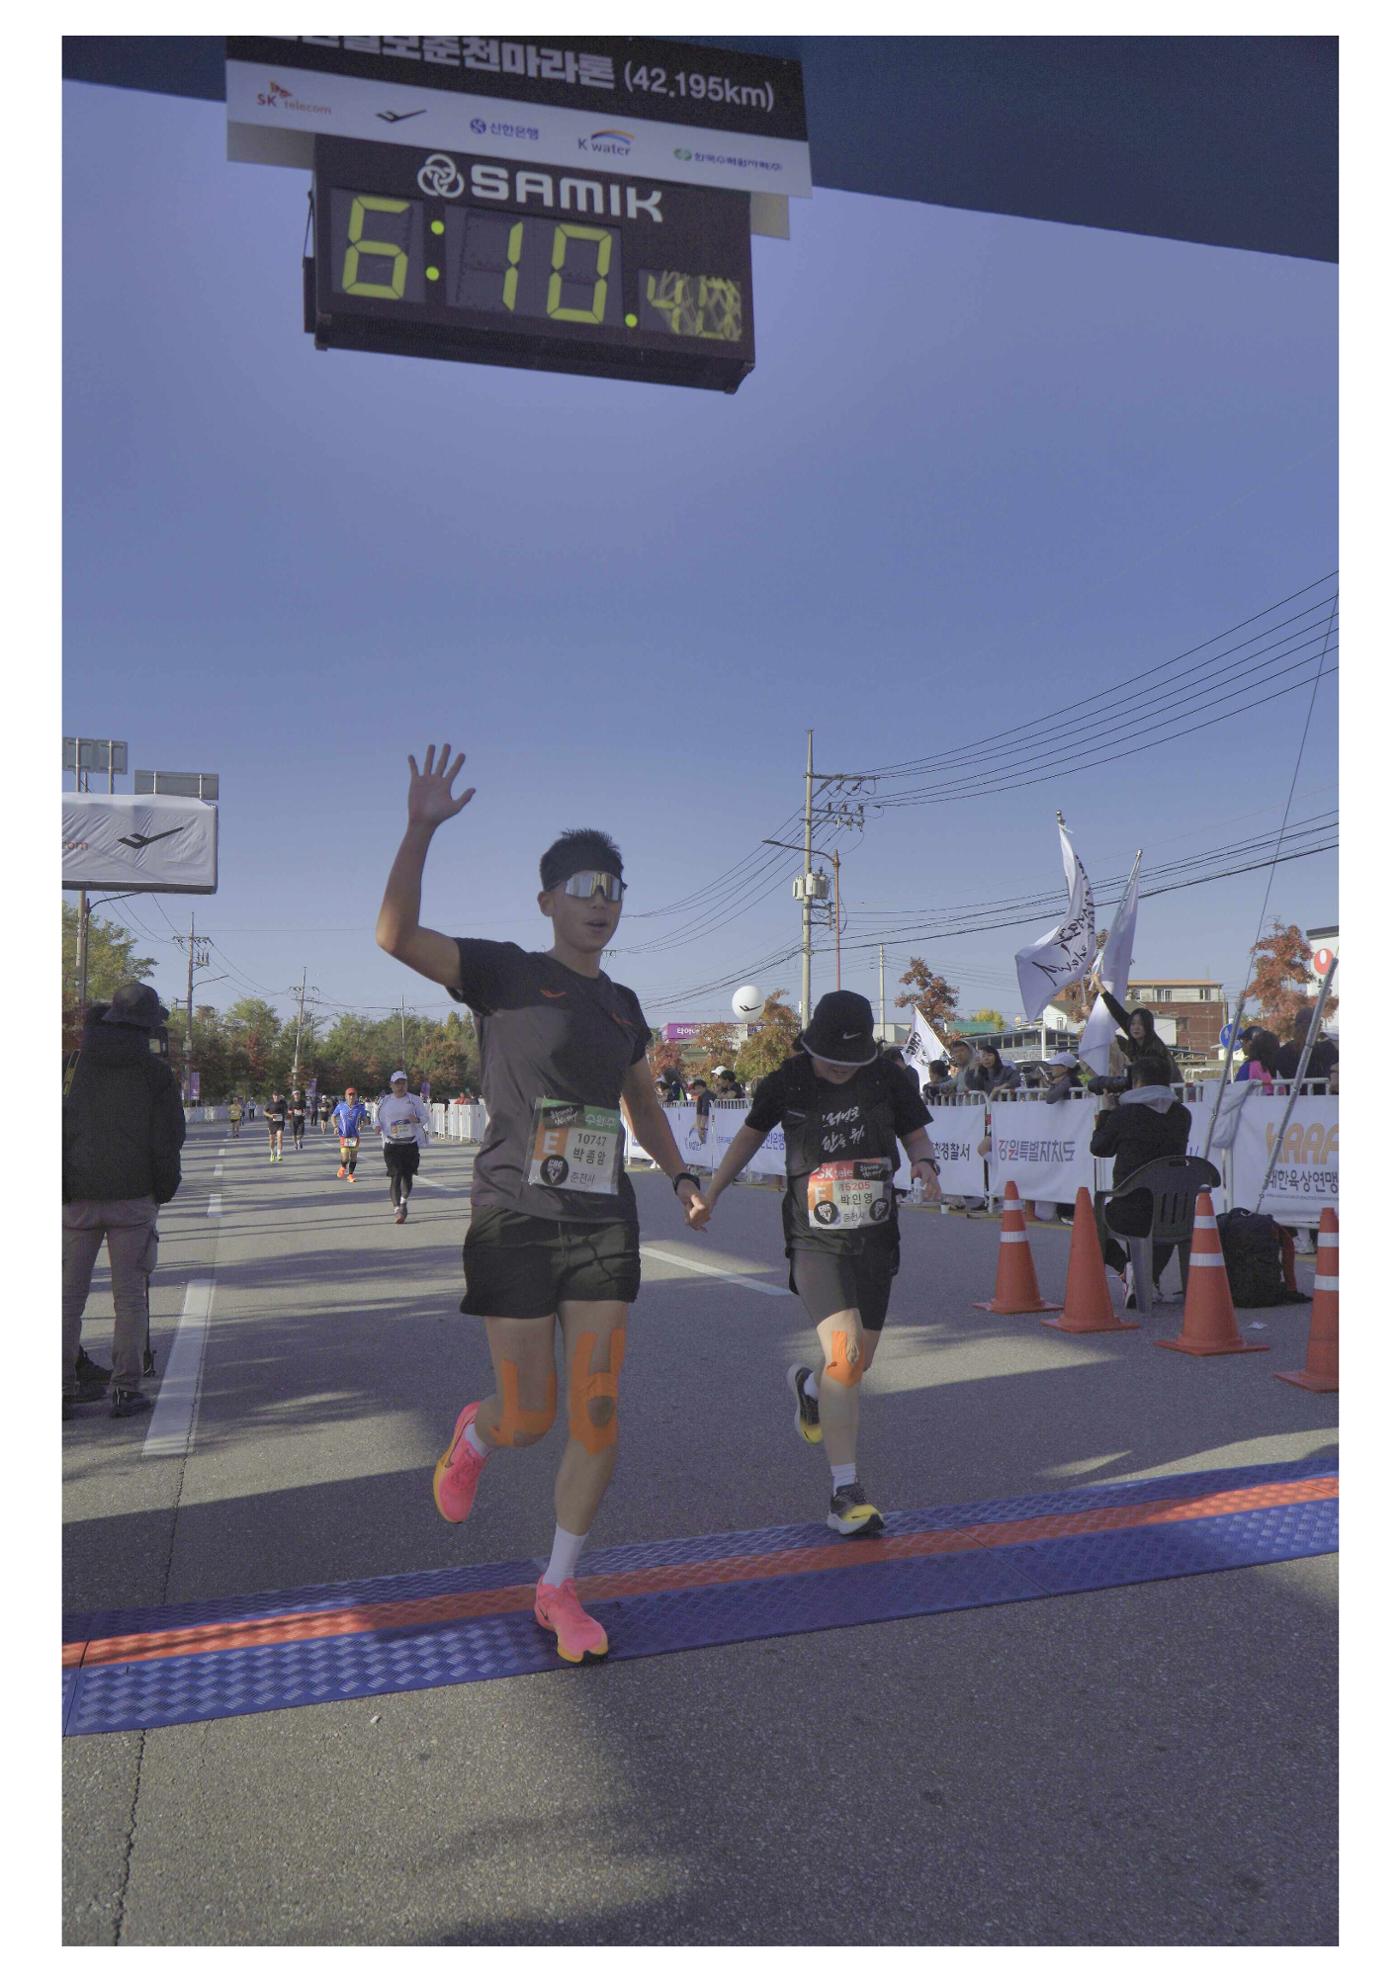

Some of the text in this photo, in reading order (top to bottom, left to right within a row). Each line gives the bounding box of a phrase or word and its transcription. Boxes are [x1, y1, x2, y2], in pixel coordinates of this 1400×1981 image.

[268, 36, 775, 113] 보춘천마라톤 (42.195km)
[257, 93, 332, 116] SK telecom
[489, 121, 540, 141] 신한은행
[578, 137, 632, 157] K water
[471, 163, 664, 224] SAMIK
[542, 1131, 560, 1155] E
[577, 1133, 607, 1147] 10747
